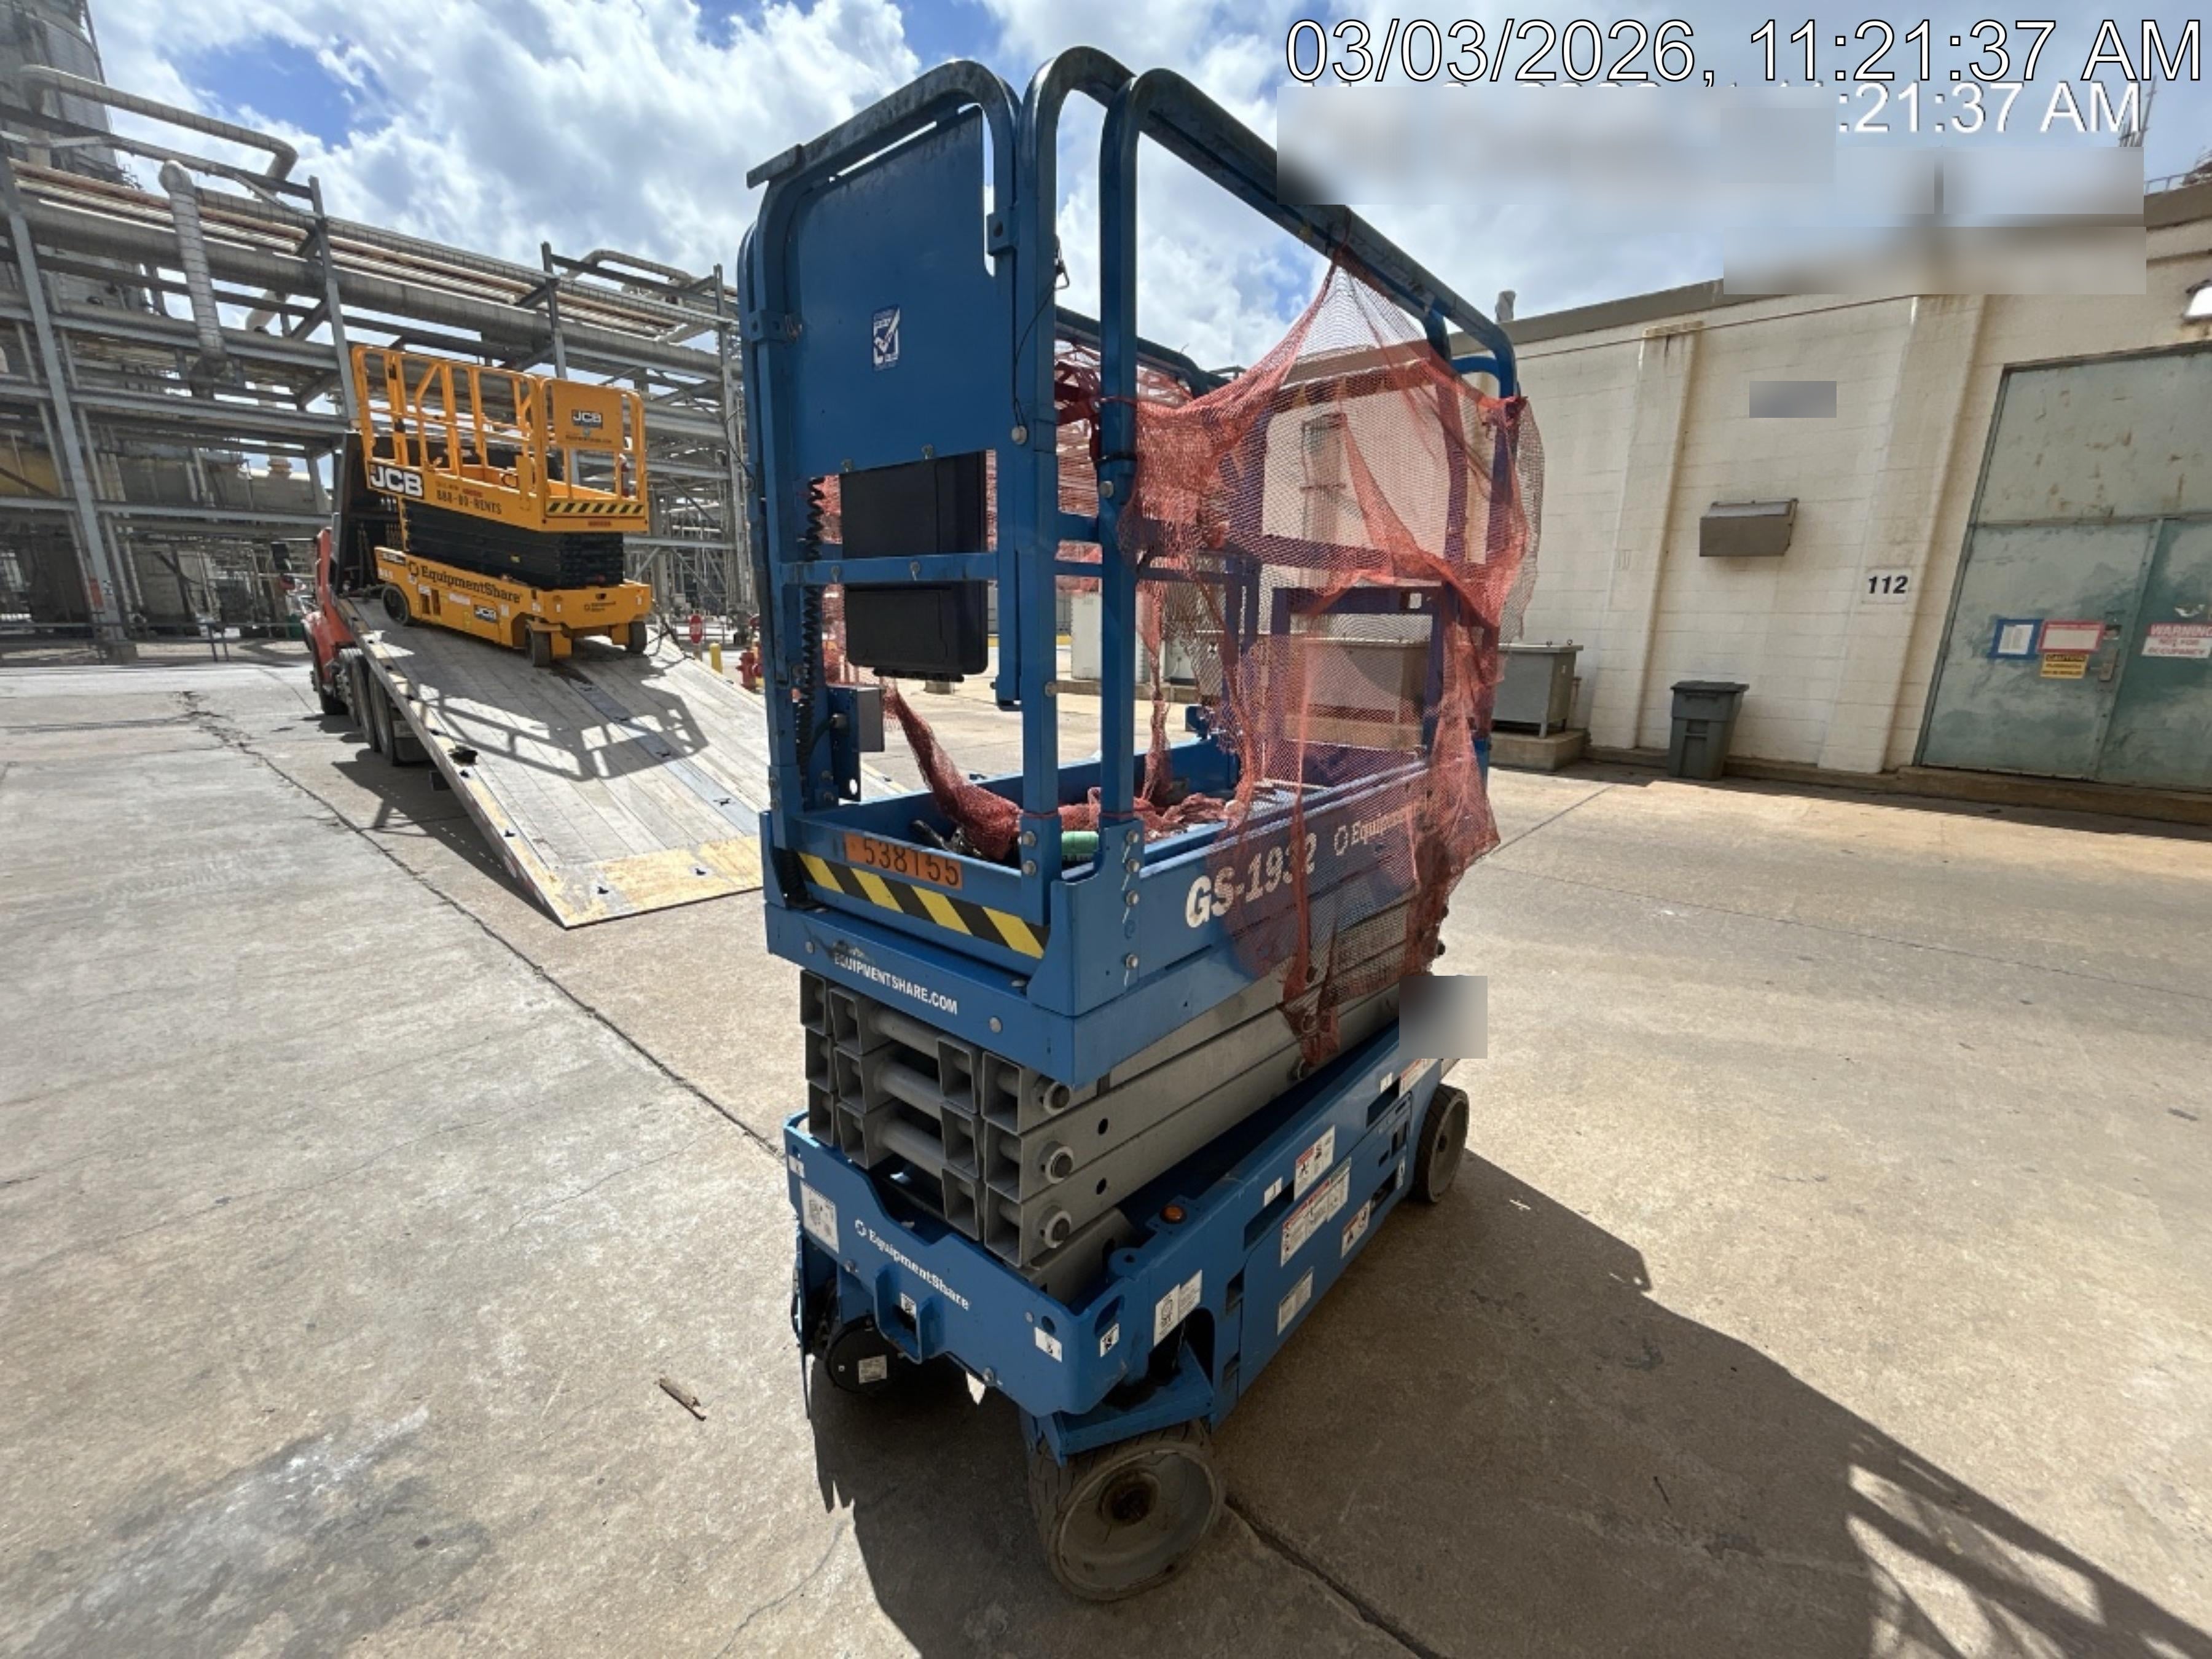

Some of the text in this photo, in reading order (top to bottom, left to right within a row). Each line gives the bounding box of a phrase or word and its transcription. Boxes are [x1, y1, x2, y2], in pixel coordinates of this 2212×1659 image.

[370, 465, 423, 497] JCB
[422, 565, 521, 603] EquipmentShare
[1868, 575, 1908, 594] 112
[863, 837, 959, 885] 538155
[869, 1228, 969, 1311] EquipmentShare
